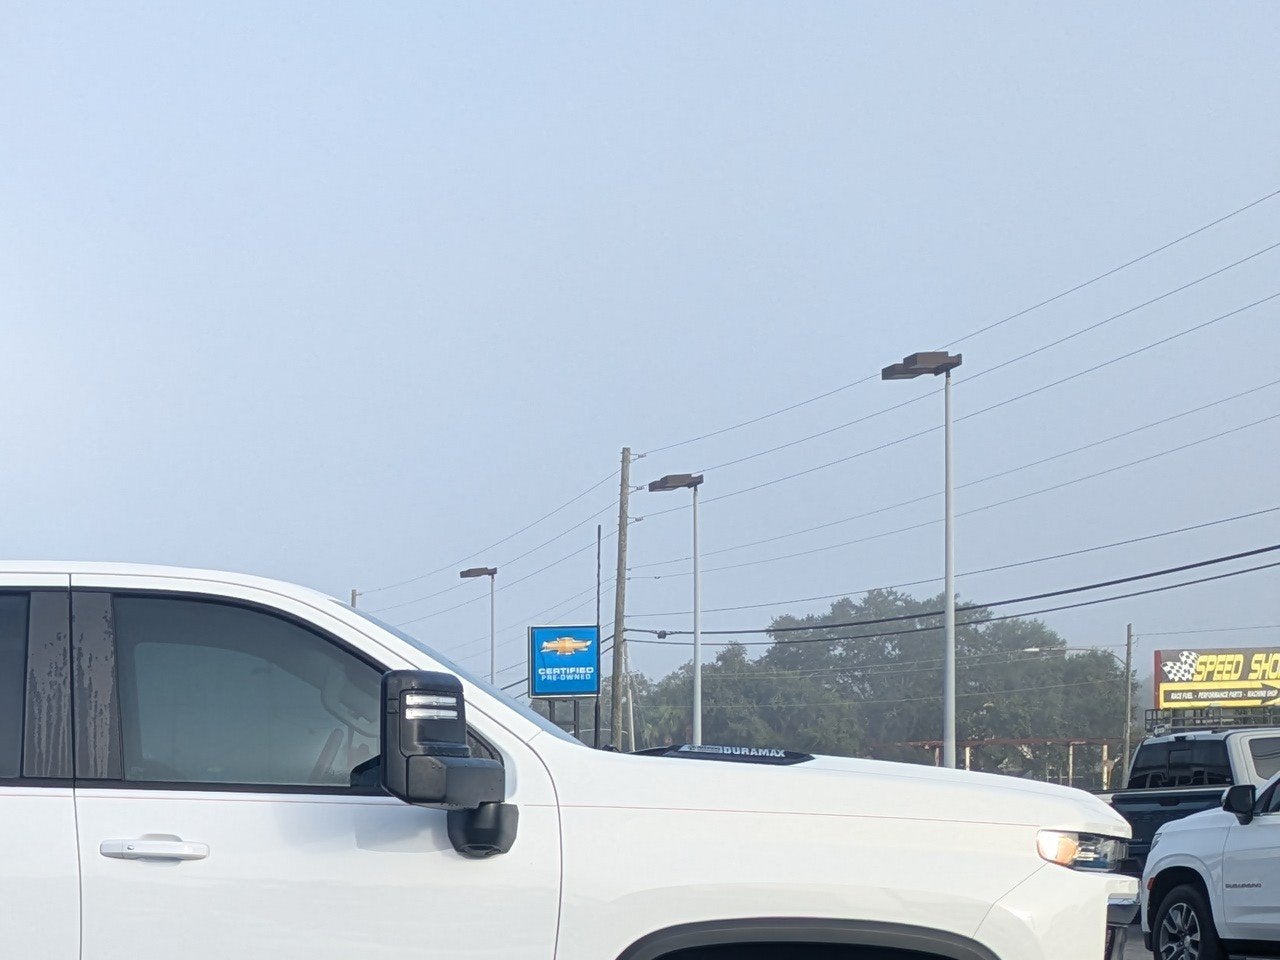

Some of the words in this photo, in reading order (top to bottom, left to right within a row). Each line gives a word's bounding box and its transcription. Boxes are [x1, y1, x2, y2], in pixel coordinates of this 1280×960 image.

[538, 667, 594, 675] CERTIFIED
[1192, 653, 1244, 681] SPEED
[1248, 652, 1280, 680] SHO
[1198, 691, 1228, 699] PERFORMANCE
[1247, 690, 1266, 698] MACHINE
[723, 746, 786, 758] DURAMAX
